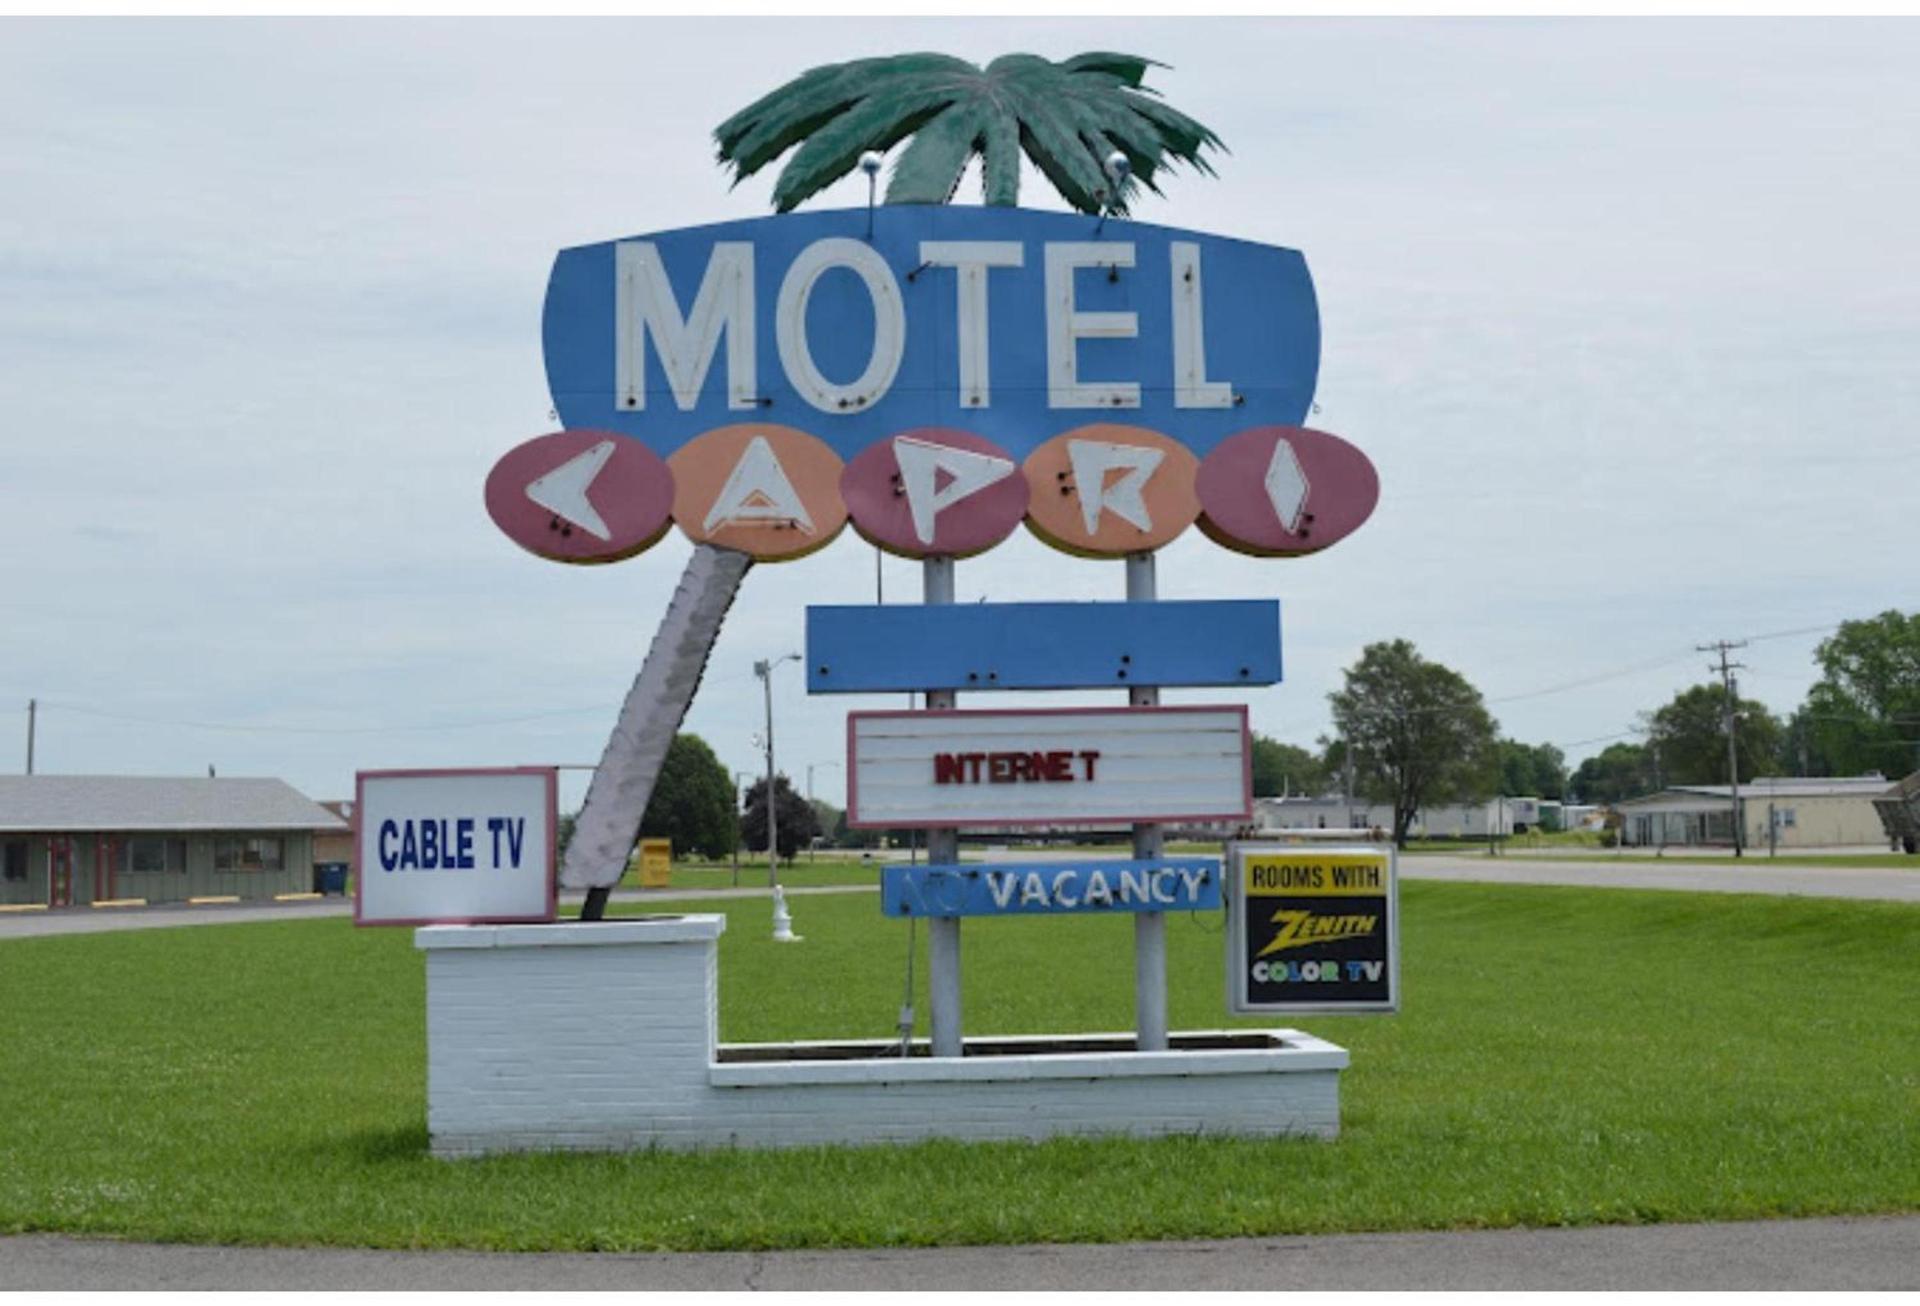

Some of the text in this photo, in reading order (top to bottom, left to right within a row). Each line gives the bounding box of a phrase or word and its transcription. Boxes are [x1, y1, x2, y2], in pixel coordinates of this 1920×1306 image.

[614, 237, 1233, 415] MOTEL
[524, 435, 1312, 546] CAPRI
[933, 750, 1100, 785] INTERNET
[378, 816, 525, 872] CABLE TV
[985, 866, 1207, 909] VACANCY
[1252, 864, 1379, 888] ROOMS WITH
[1255, 909, 1378, 957] ZENITH
[1252, 960, 1384, 983] COLOR TV
